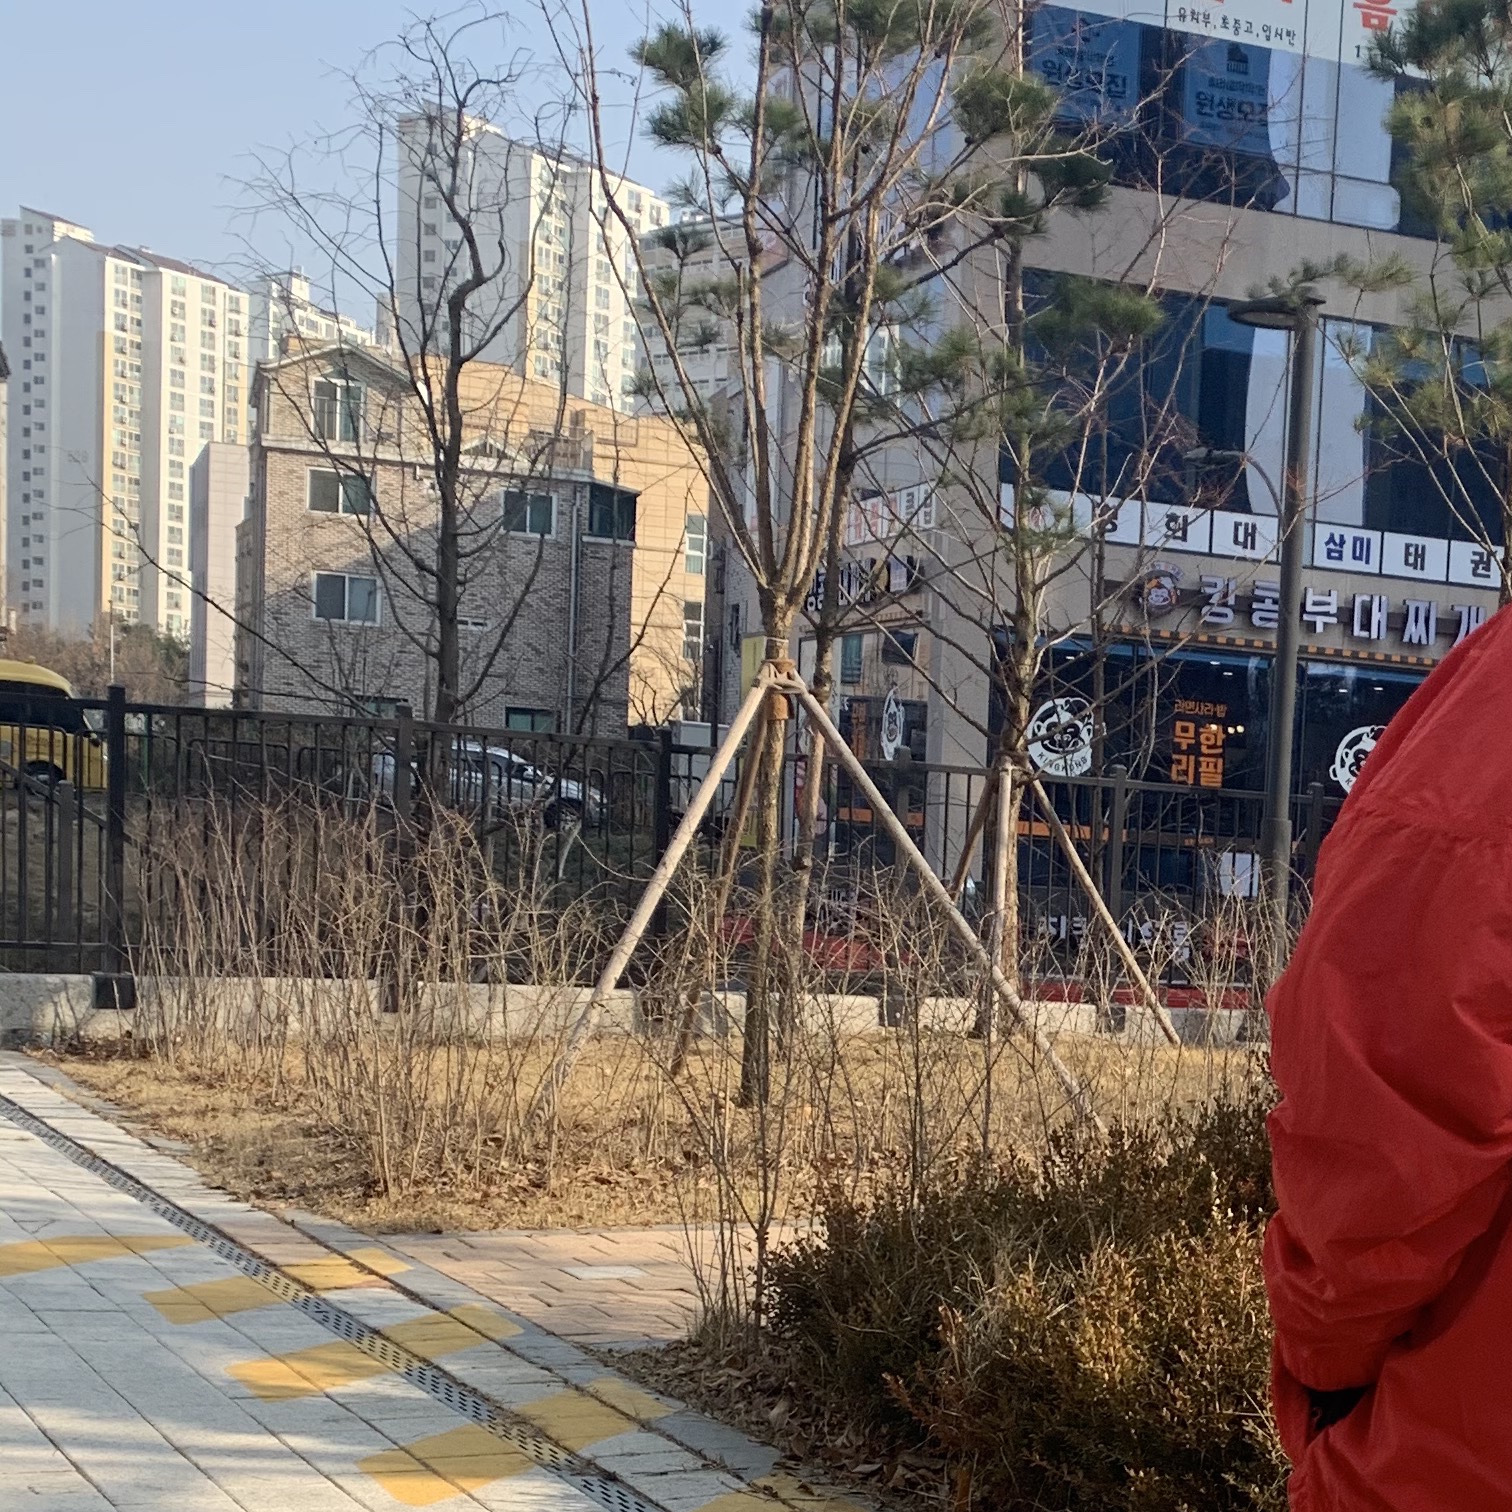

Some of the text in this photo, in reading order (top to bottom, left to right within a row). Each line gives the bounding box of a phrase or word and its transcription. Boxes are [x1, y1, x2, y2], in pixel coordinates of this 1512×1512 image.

[1324, 531, 1371, 565] 삼미
[1173, 721, 1226, 755] 무한
[1171, 753, 1224, 789] 리필
